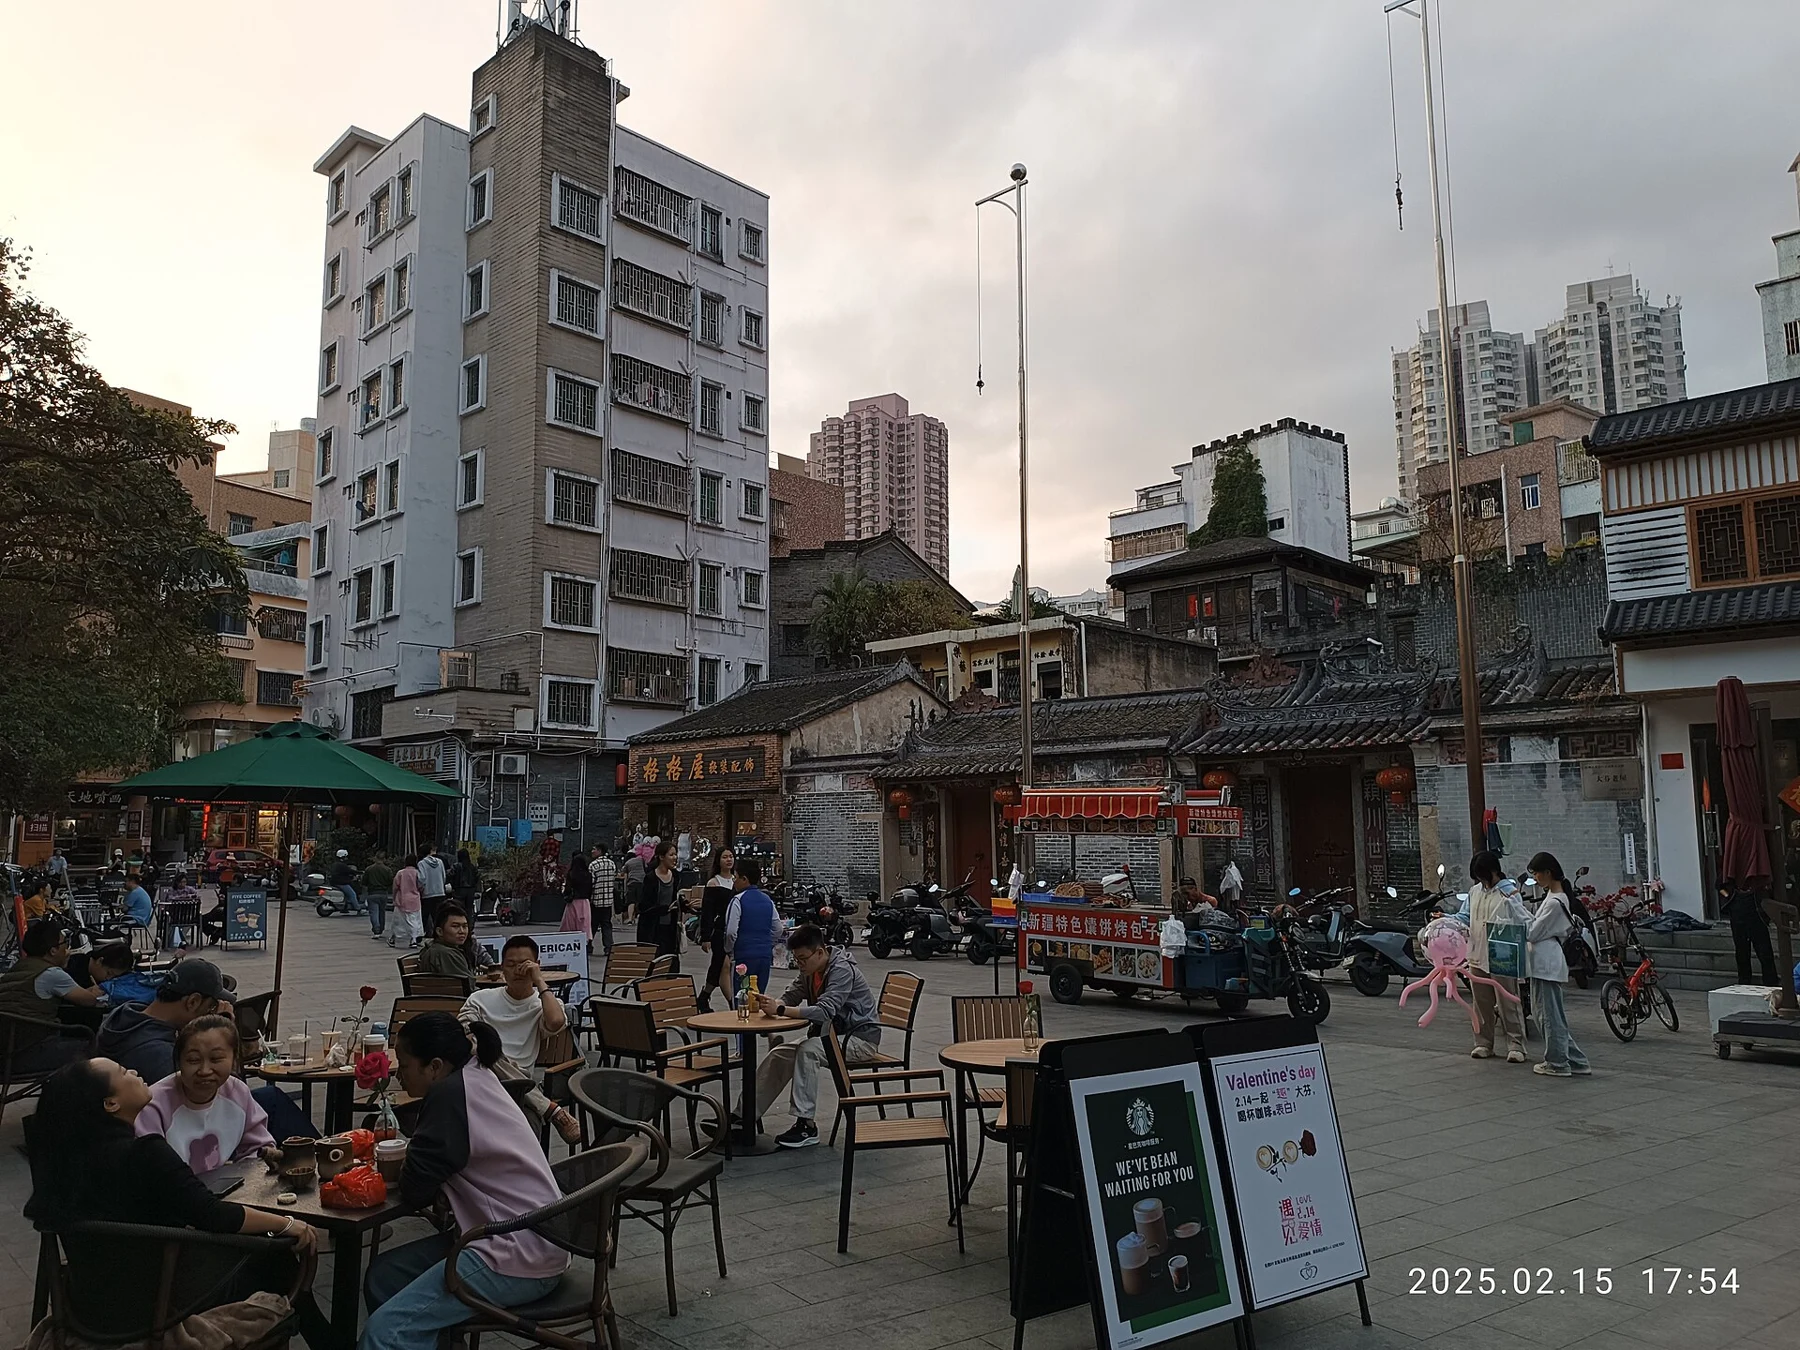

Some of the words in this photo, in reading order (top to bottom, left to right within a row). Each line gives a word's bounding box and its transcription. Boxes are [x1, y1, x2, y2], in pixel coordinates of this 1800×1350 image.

[642, 753, 704, 783] 格格屋
[539, 942, 582, 954] ERICAN
[1226, 1066, 1297, 1091] Valentine's
[1298, 1065, 1317, 1081] day
[1150, 1150, 1179, 1170] BEAN
[1104, 1174, 1151, 1198] WAITING
[1151, 1170, 1173, 1188] FOR
[1173, 1165, 1195, 1183] YOU
